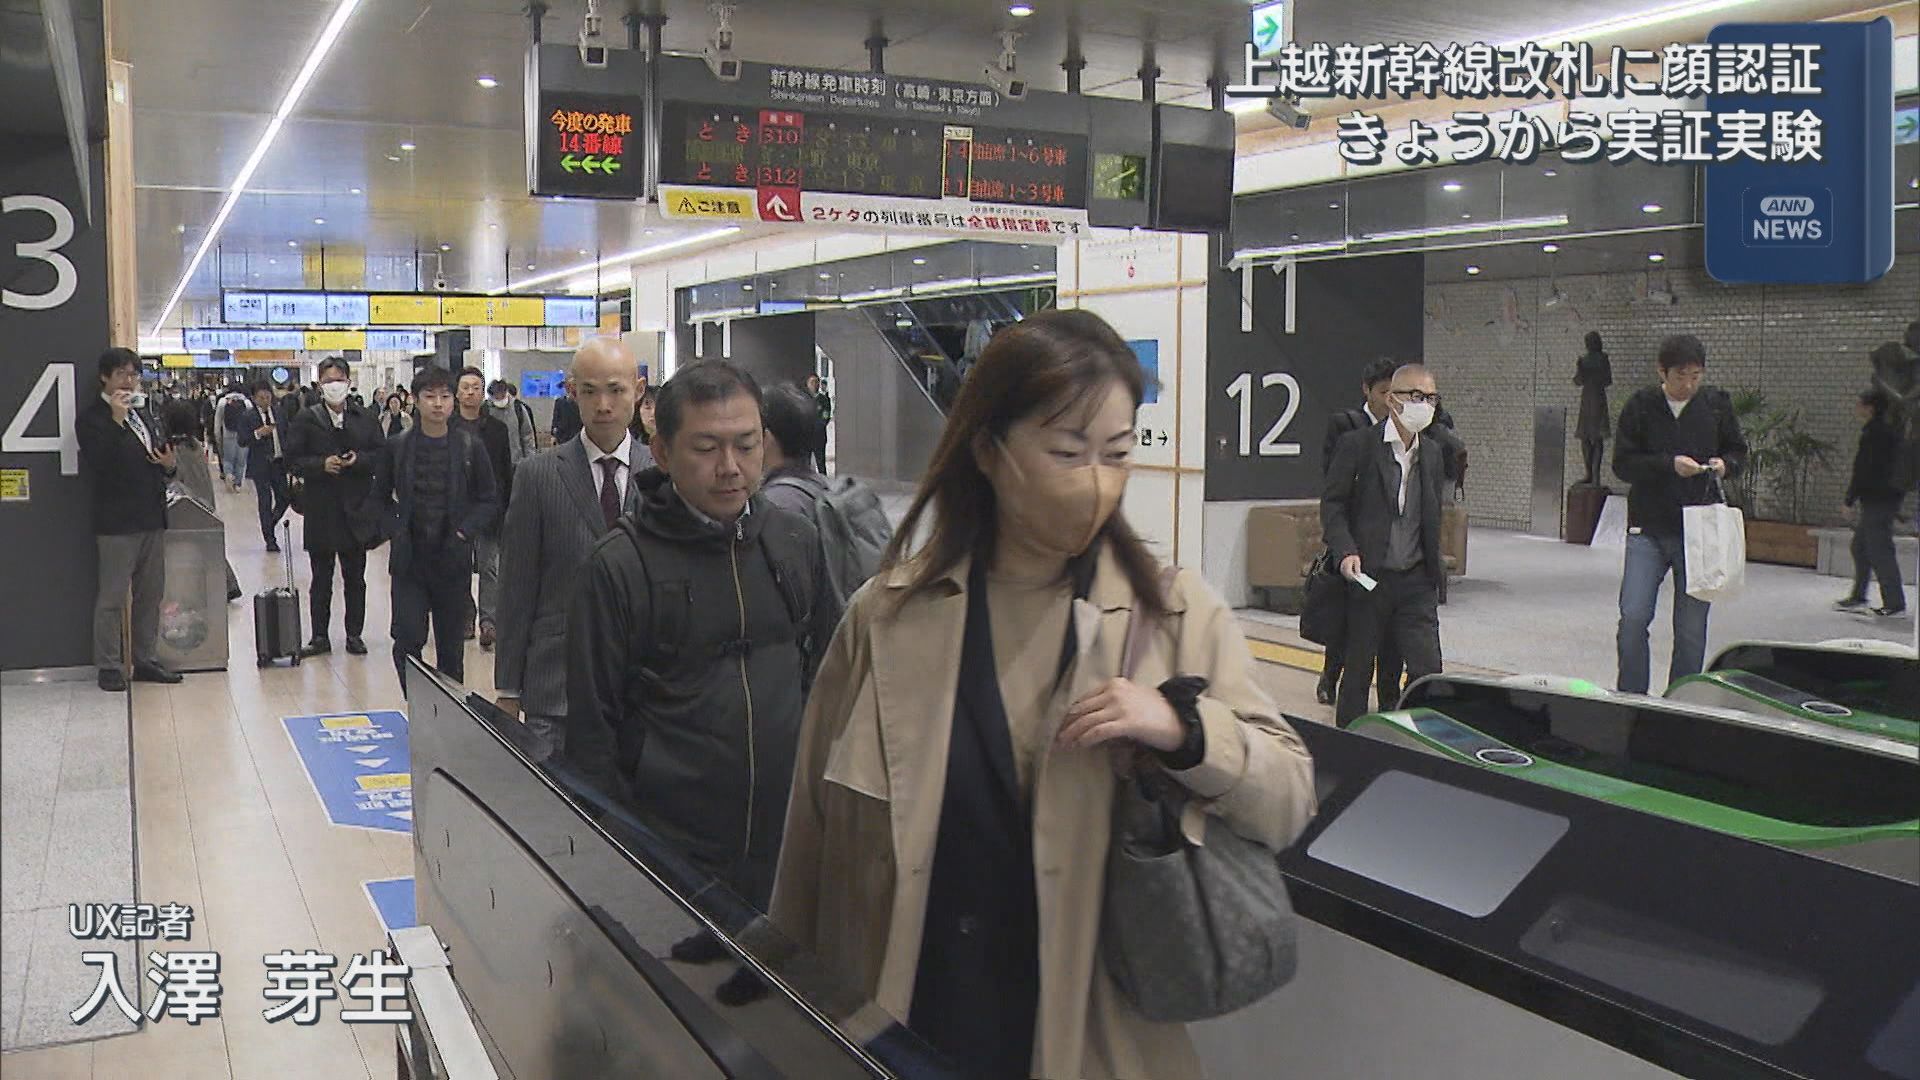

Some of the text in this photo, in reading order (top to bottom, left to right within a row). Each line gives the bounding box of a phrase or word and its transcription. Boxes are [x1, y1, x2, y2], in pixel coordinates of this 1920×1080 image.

[551, 109, 633, 136] 今度の発車
[763, 125, 799, 146] 310
[560, 131, 625, 156] 14番線
[762, 166, 797, 185] 312
[1226, 255, 1297, 334] 11
[1226, 372, 1301, 457] 12
